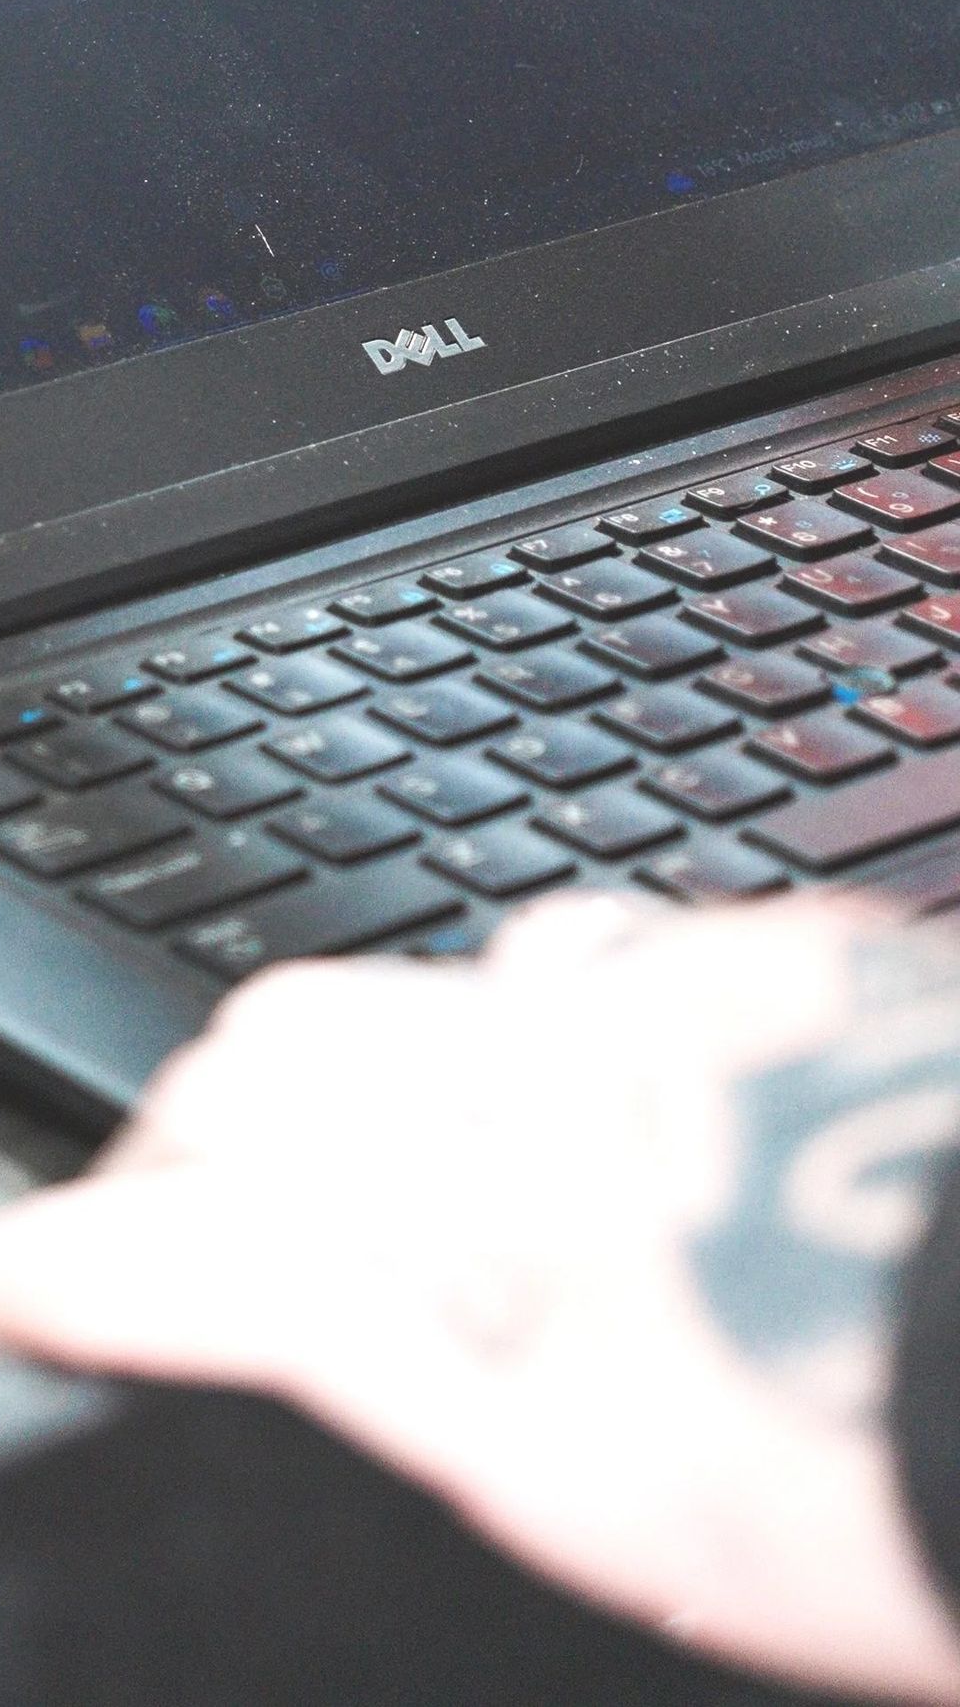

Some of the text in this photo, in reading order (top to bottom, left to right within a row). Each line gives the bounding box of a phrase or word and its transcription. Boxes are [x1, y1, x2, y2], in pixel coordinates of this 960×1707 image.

[362, 318, 488, 375] DELL
[865, 435, 898, 447] F11
[780, 460, 817, 474] F10
[696, 487, 725, 499] F9
[888, 503, 915, 513] 9
[792, 530, 818, 542] 8
